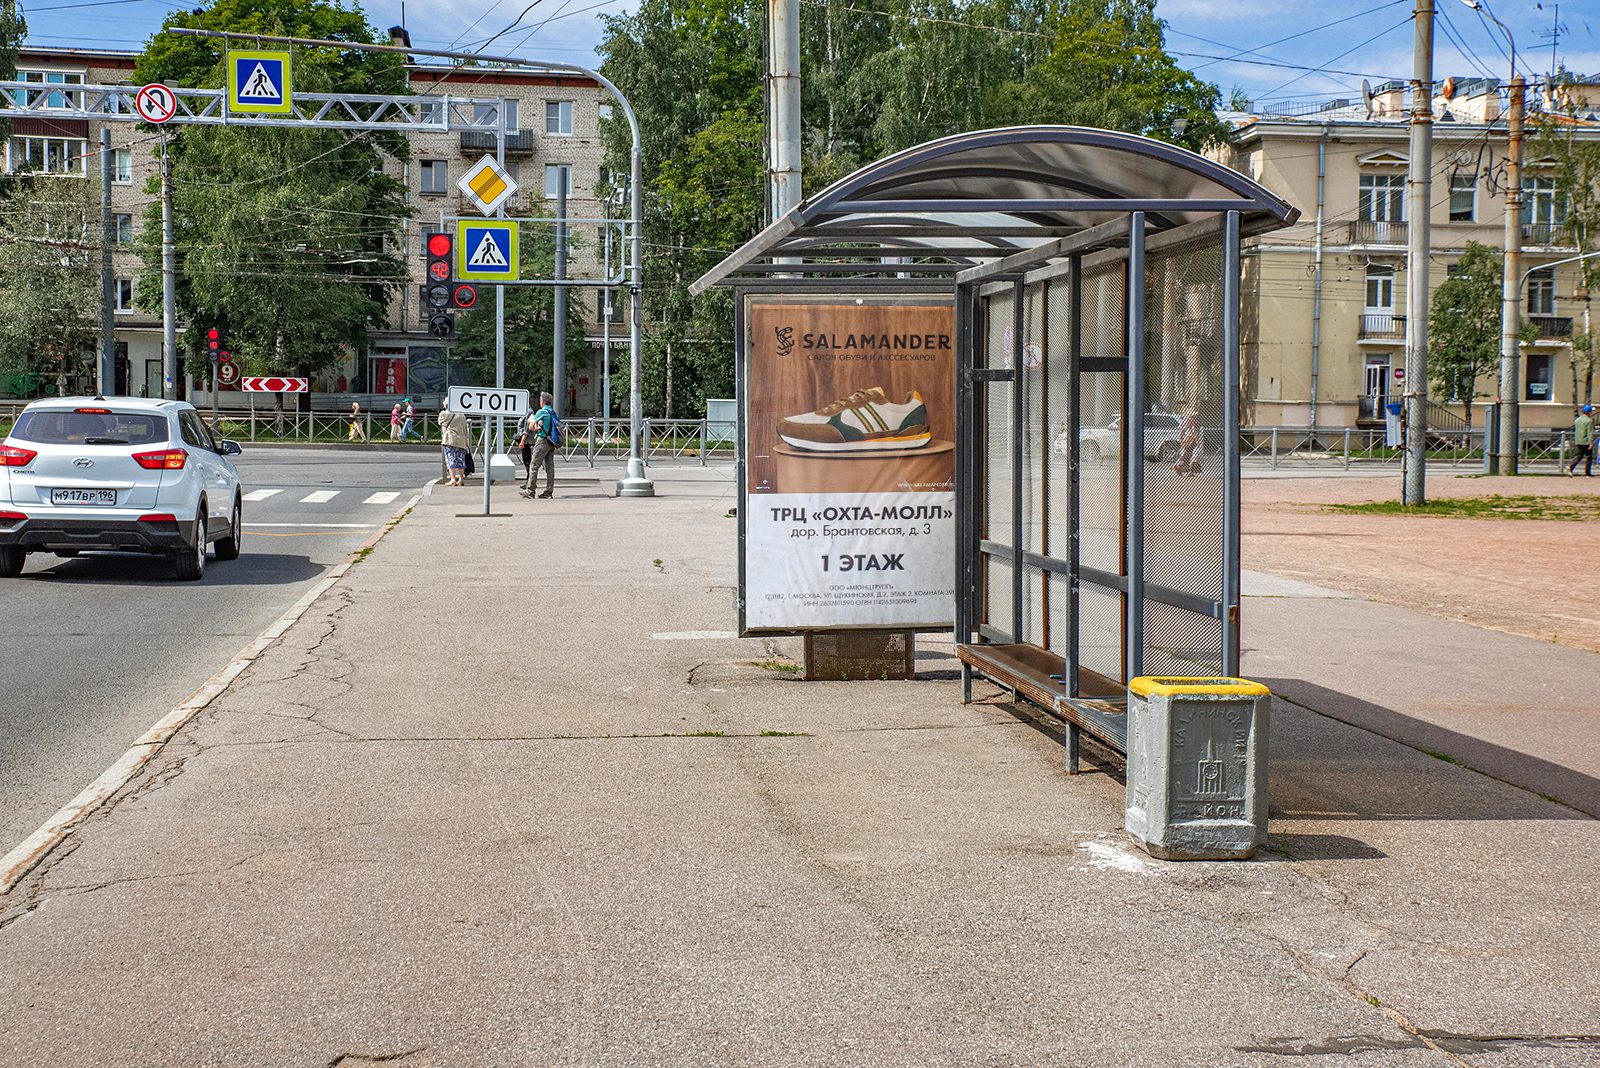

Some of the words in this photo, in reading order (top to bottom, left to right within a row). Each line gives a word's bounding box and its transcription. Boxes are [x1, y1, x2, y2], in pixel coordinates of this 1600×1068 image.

[431, 263, 449, 279] 42
[591, 341, 613, 349] ПОЧА
[803, 334, 951, 350] SALAMANDER
[221, 365, 234, 379] 9
[460, 392, 516, 412] СТОП
[98, 490, 113, 498] 196
[771, 507, 807, 524] ТРЦ
[812, 505, 953, 521] «ОХТА-МОЛЛ»
[791, 528, 819, 540] дор.
[823, 524, 905, 540] Брантовская,
[908, 527, 919, 537] д.
[923, 523, 931, 535] 3
[821, 555, 829, 572] 1
[839, 554, 905, 572] ЭТАЖ
